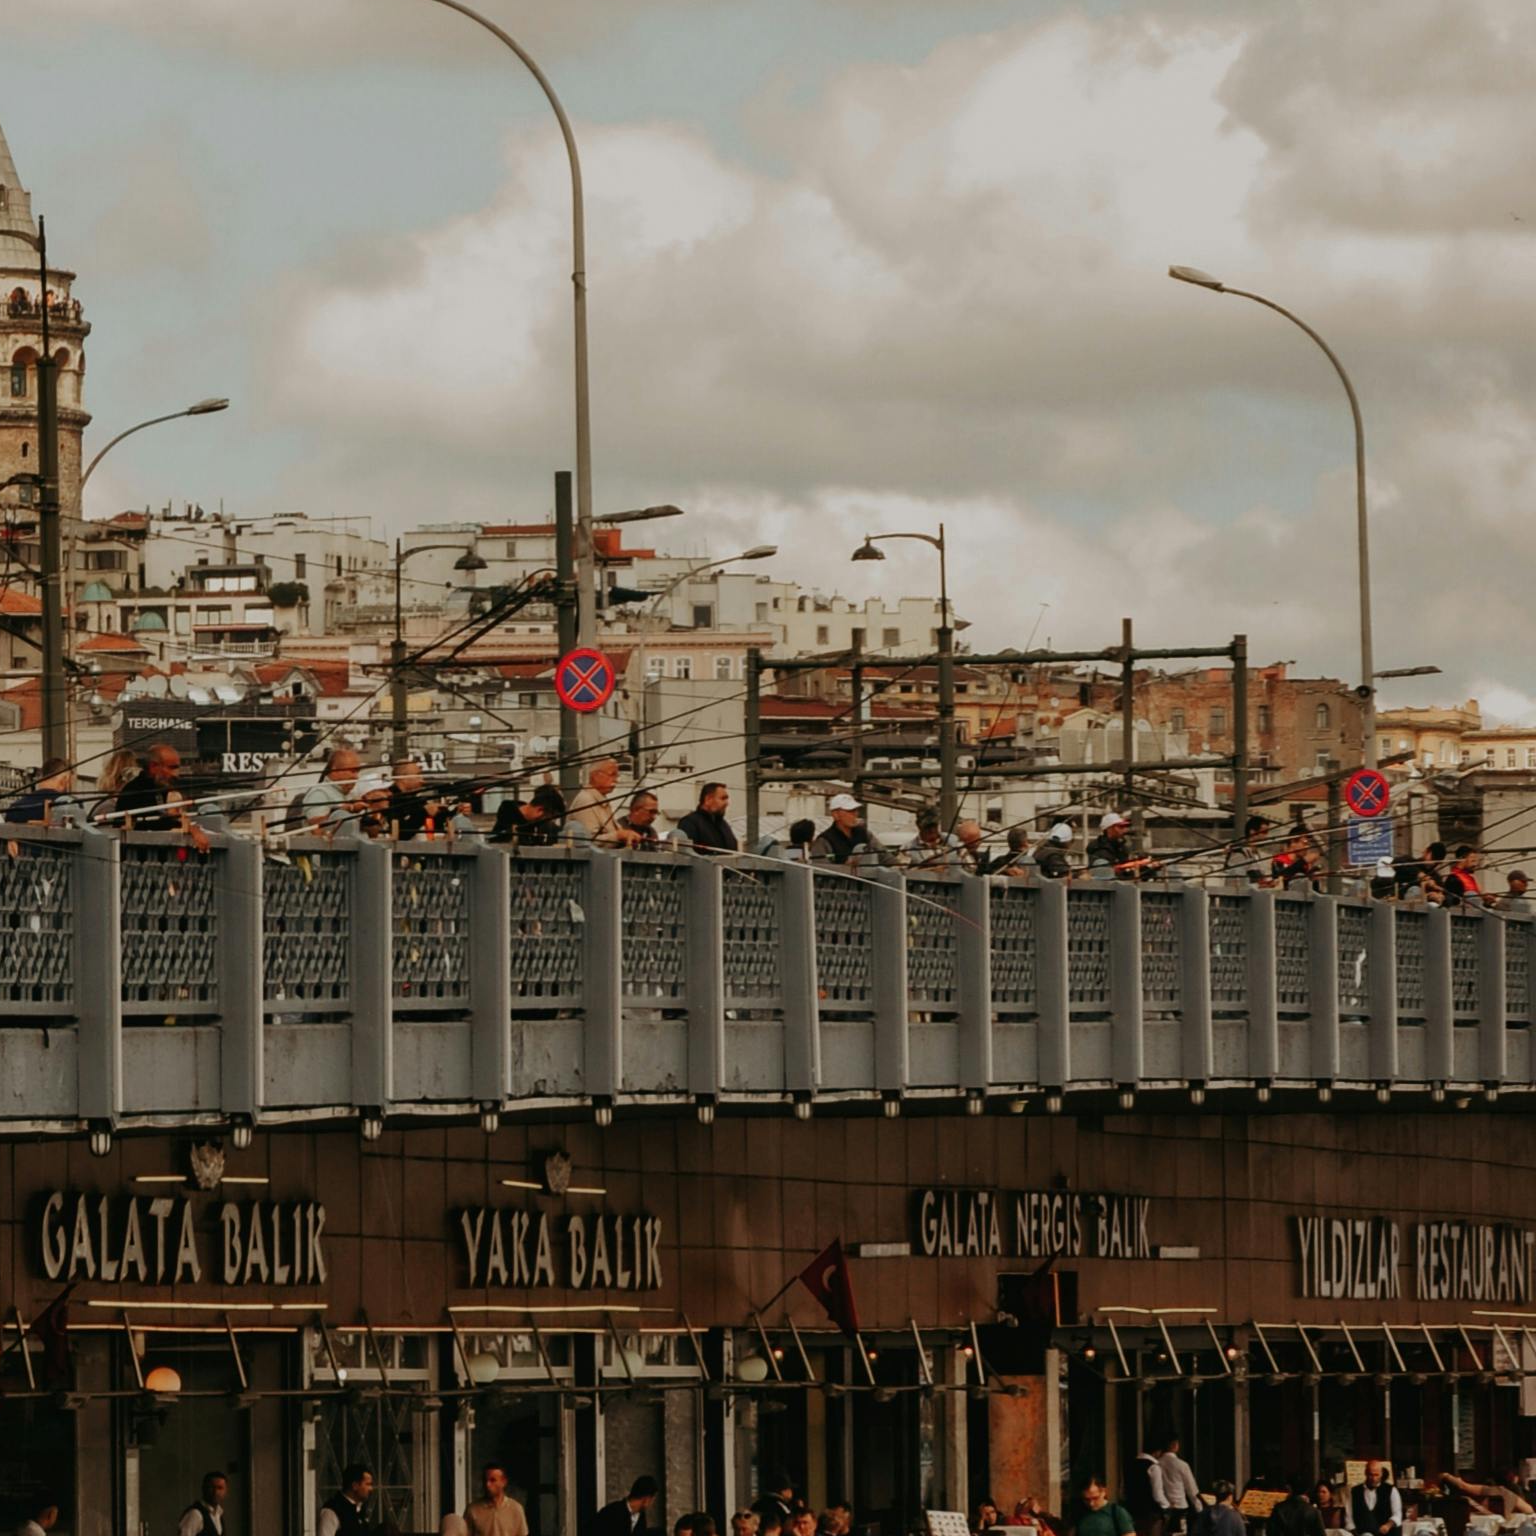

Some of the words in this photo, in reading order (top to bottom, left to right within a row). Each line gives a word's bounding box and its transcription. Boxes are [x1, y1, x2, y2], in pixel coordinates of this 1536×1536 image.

[41, 1190, 202, 1285] GALATA
[220, 1200, 328, 1286] BALIK
[461, 1209, 556, 1288] YAKA
[567, 1215, 663, 1290] BALIK
[920, 1190, 1002, 1257] GALATA
[1096, 1194, 1151, 1259] BALIK
[1297, 1216, 1401, 1300] YILDIZLAR
[1416, 1221, 1536, 1303] RESTAURANT
